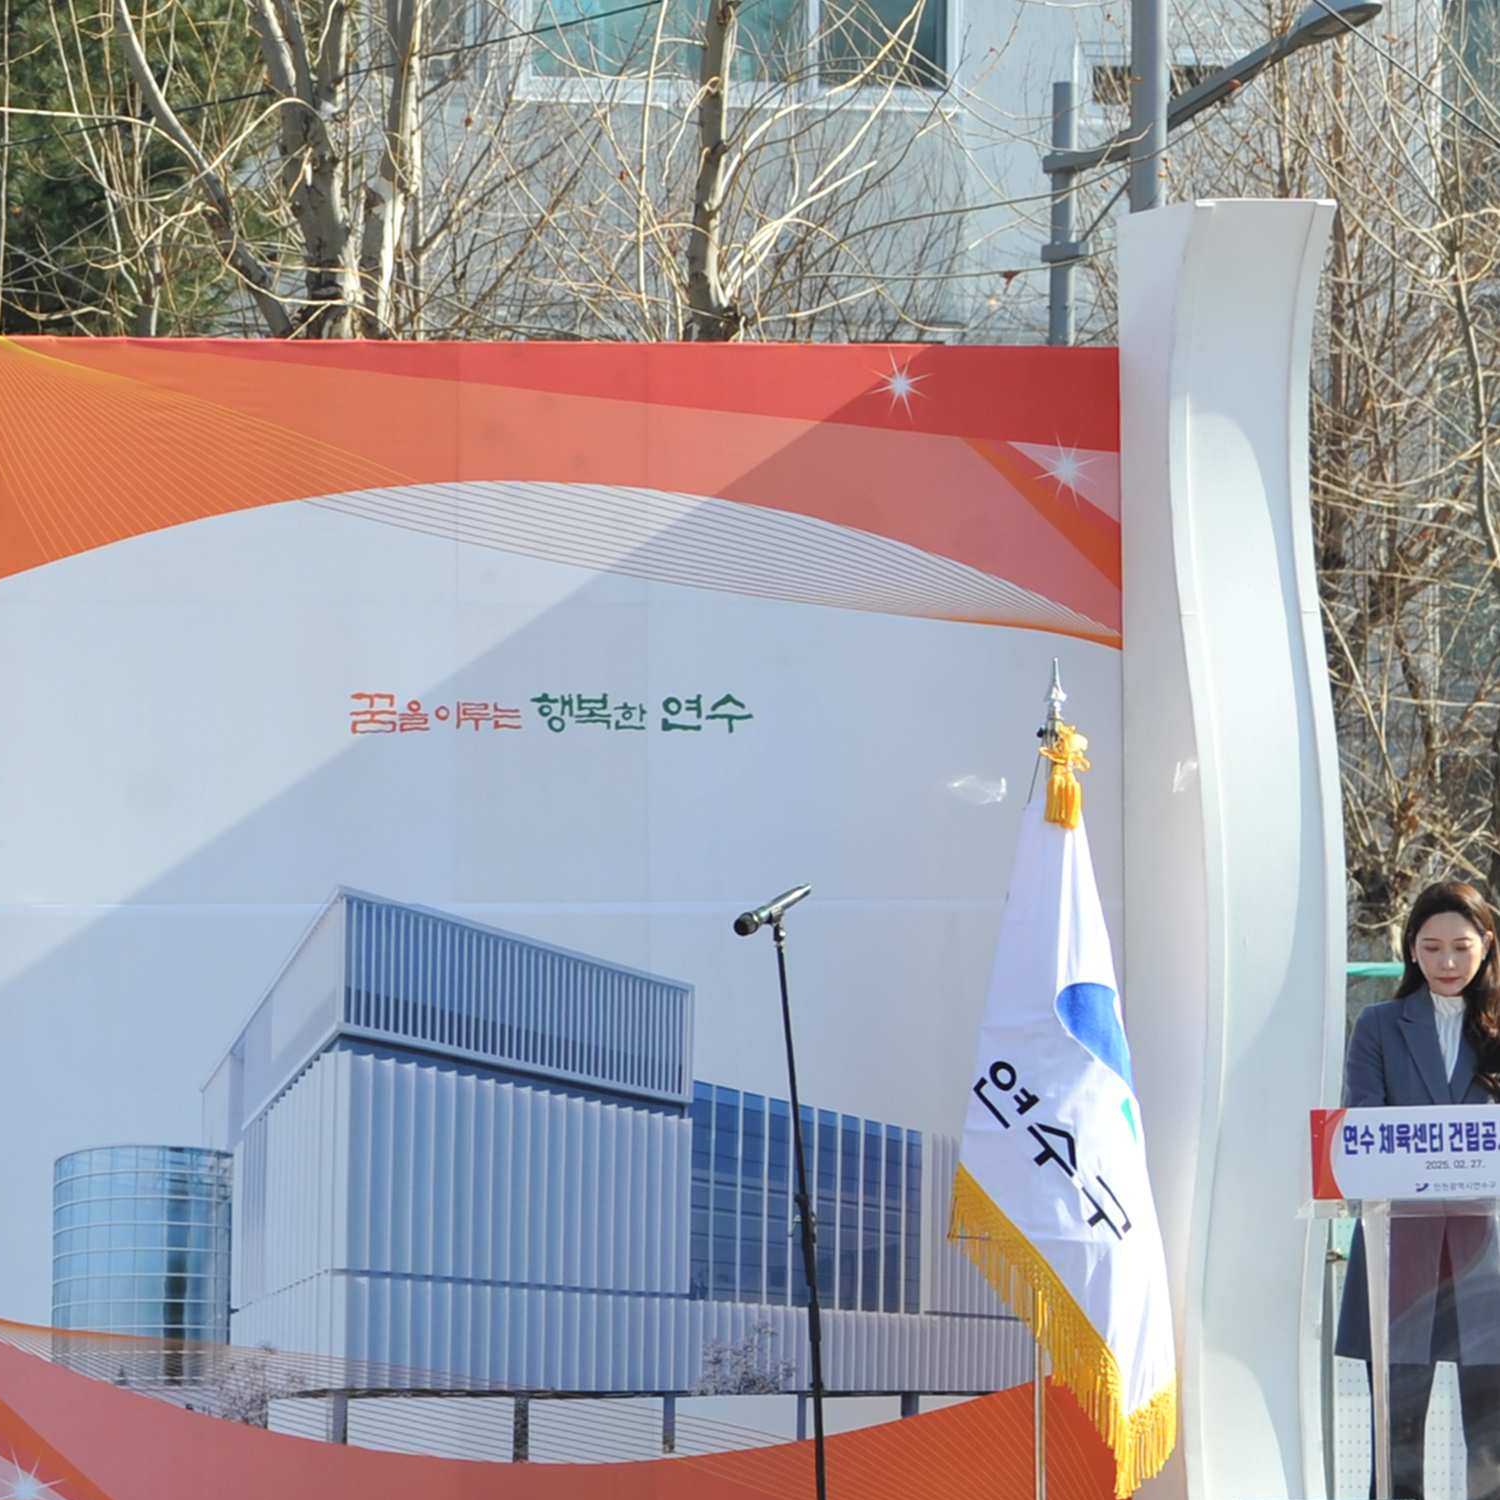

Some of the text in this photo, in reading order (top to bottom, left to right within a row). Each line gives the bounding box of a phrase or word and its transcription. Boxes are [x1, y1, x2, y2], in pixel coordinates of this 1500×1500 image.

[530, 692, 647, 733] 행복한
[661, 693, 754, 734] 연수
[972, 1060, 1133, 1241] 연수구
[1343, 1121, 1500, 1155] 연수 체육센터 건립공
[1425, 1159, 1485, 1170] 2025. 02. 27.
